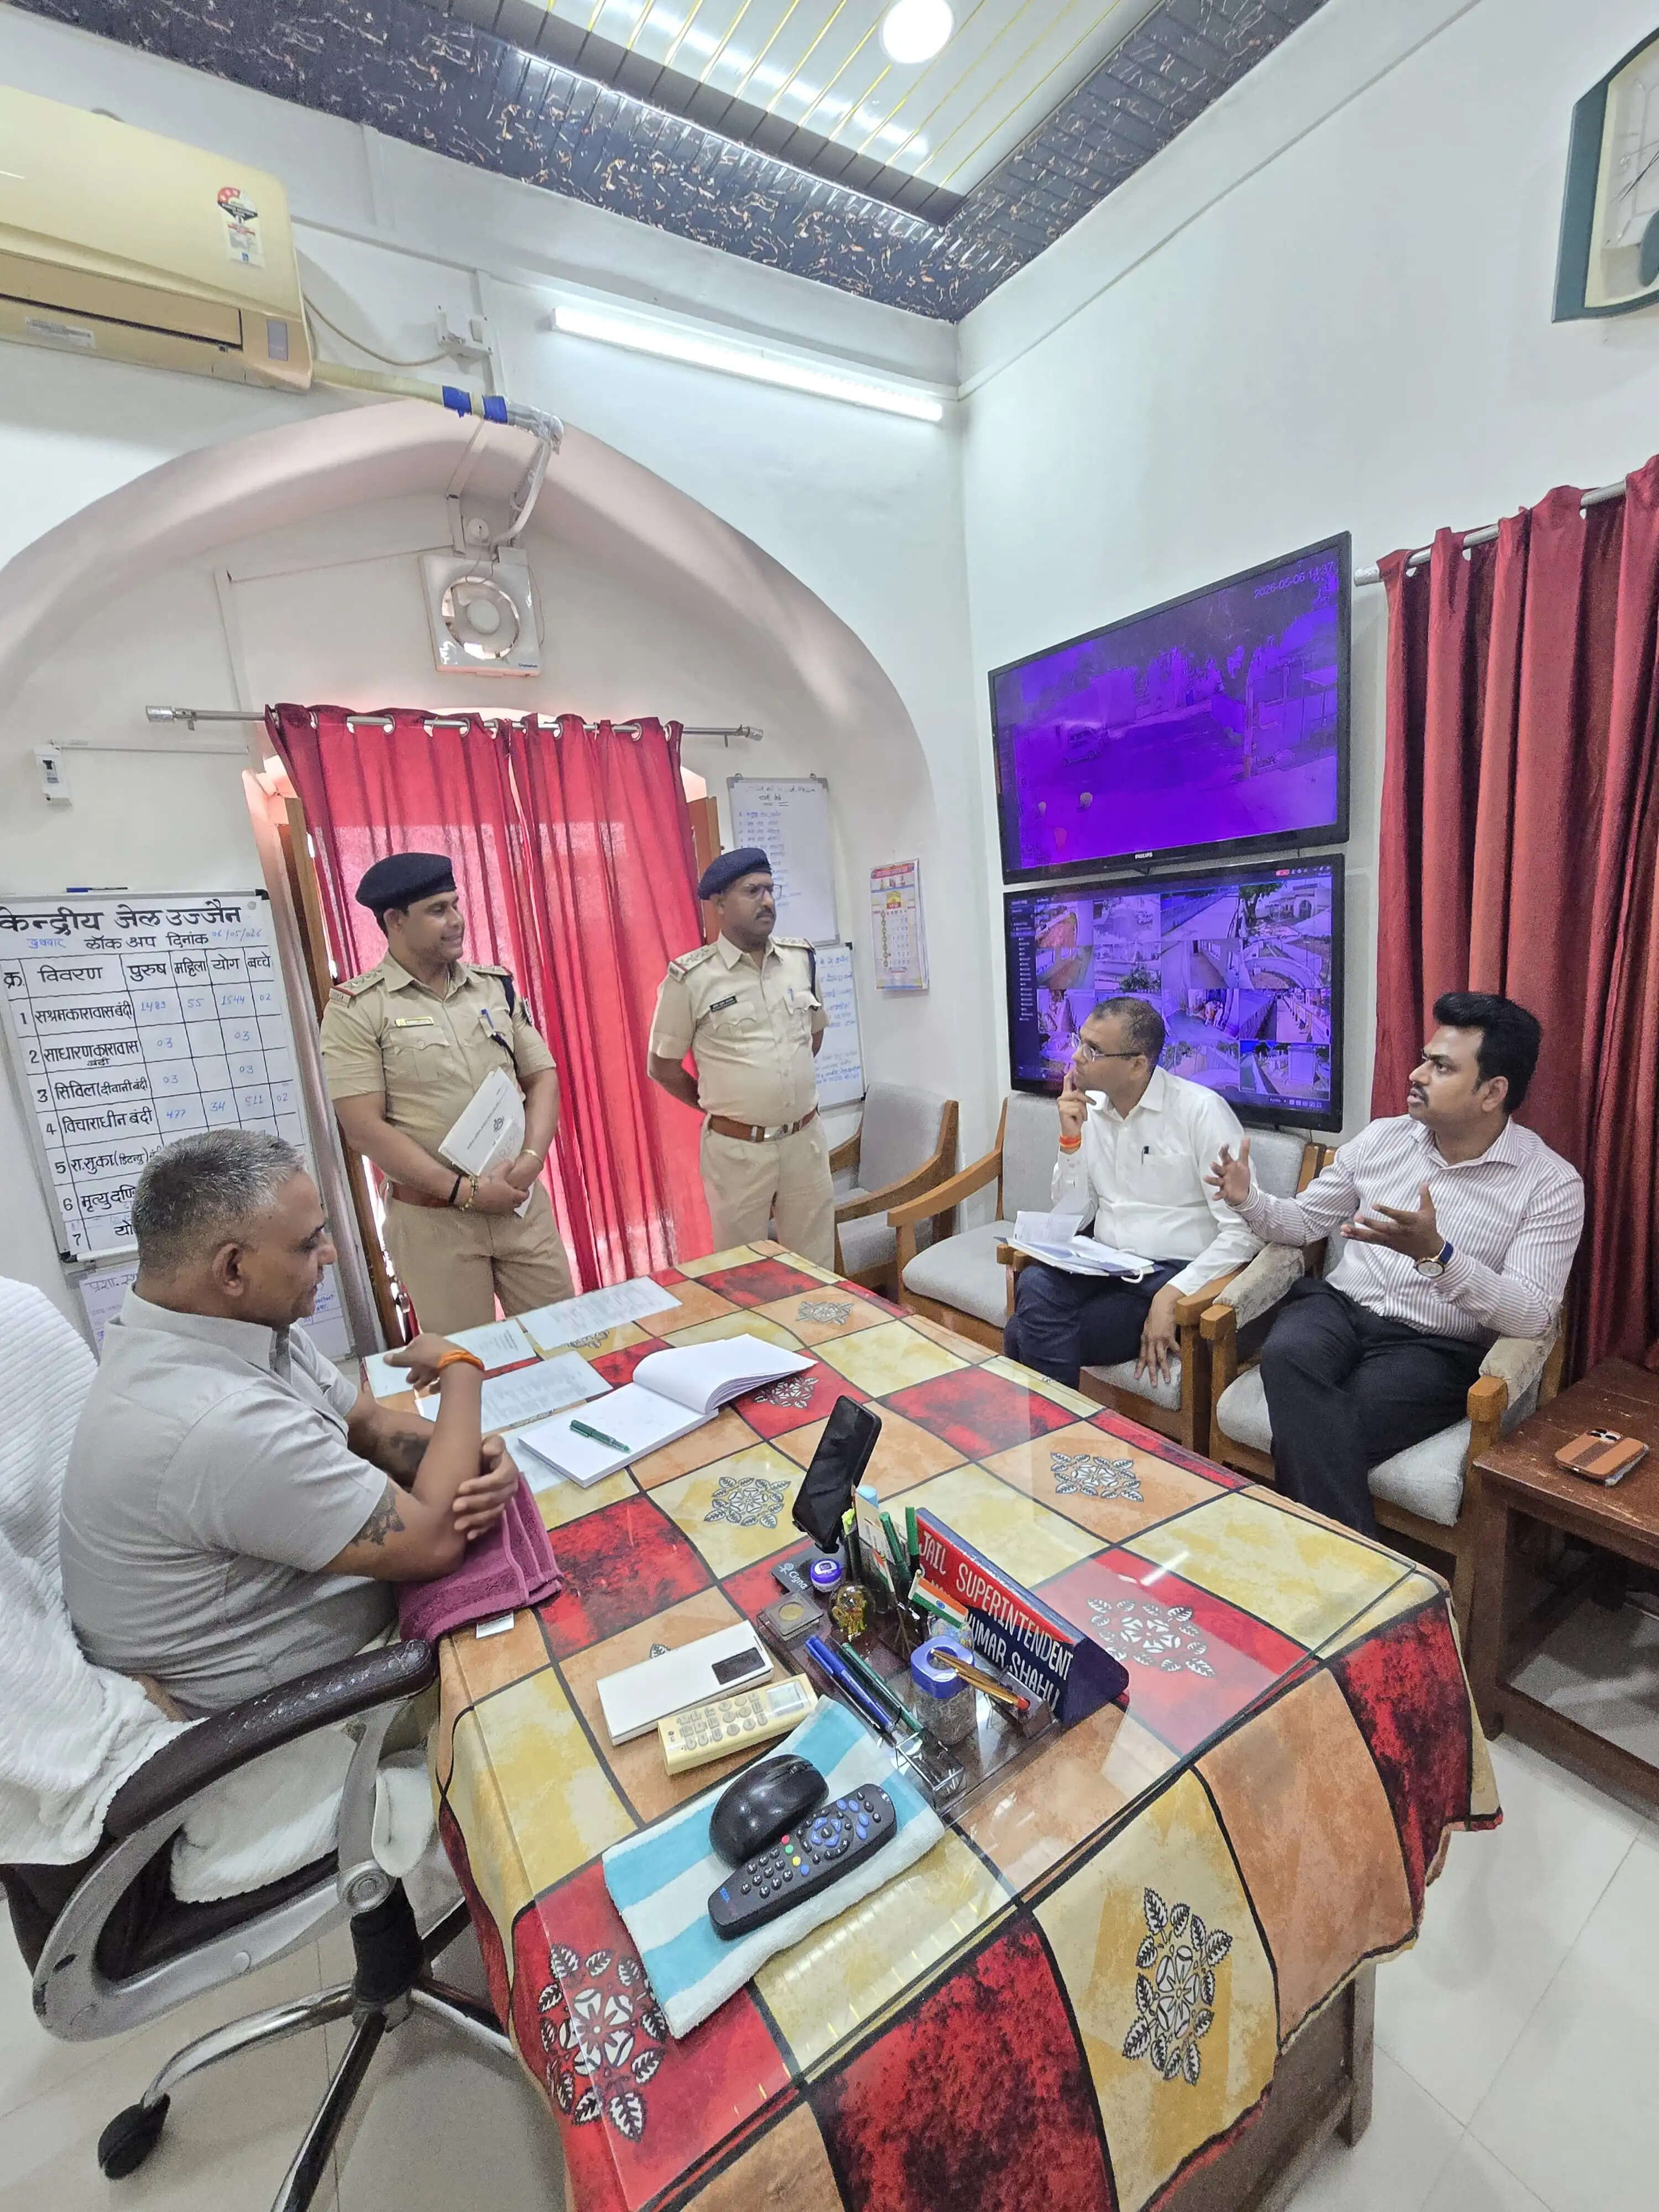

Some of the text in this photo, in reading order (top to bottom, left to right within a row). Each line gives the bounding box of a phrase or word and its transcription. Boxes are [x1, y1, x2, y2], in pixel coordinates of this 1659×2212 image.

[114, 904, 163, 928] जेल
[166, 899, 241, 926] उज्जैन
[84, 935, 122, 950] लॉक
[126, 936, 156, 947] अप
[166, 932, 208, 948] दिनांक
[37, 965, 103, 983] विवरण
[127, 963, 166, 982] पुरुष
[173, 957, 207, 977] महिला
[211, 953, 240, 970] योग
[247, 951, 271, 968] बच्चे
[19, 1013, 27, 1024] 1
[187, 998, 205, 1008] 55
[221, 995, 245, 1005] 1544
[29, 1050, 39, 1063] 2
[156, 1037, 173, 1048] 03
[234, 1030, 250, 1041] 03
[37, 1089, 48, 1102] 3
[163, 1074, 179, 1084] 03
[239, 1065, 254, 1074] 03
[46, 1123, 57, 1135] 4
[62, 1110, 128, 1134] विचाराधीन
[129, 1106, 152, 1124] बंदी
[210, 1101, 226, 1112] 34
[276, 1093, 288, 1102] 02
[55, 1161, 66, 1173] 5
[62, 1198, 73, 1211] 6
[72, 1219, 133, 1246] 7 यो
[789, 1571, 808, 1590] Cigna
[919, 1531, 946, 1575] JAIL
[956, 1563, 1074, 1681] SUPERINTENDENT
[1009, 1651, 1061, 1712] SHAHU
